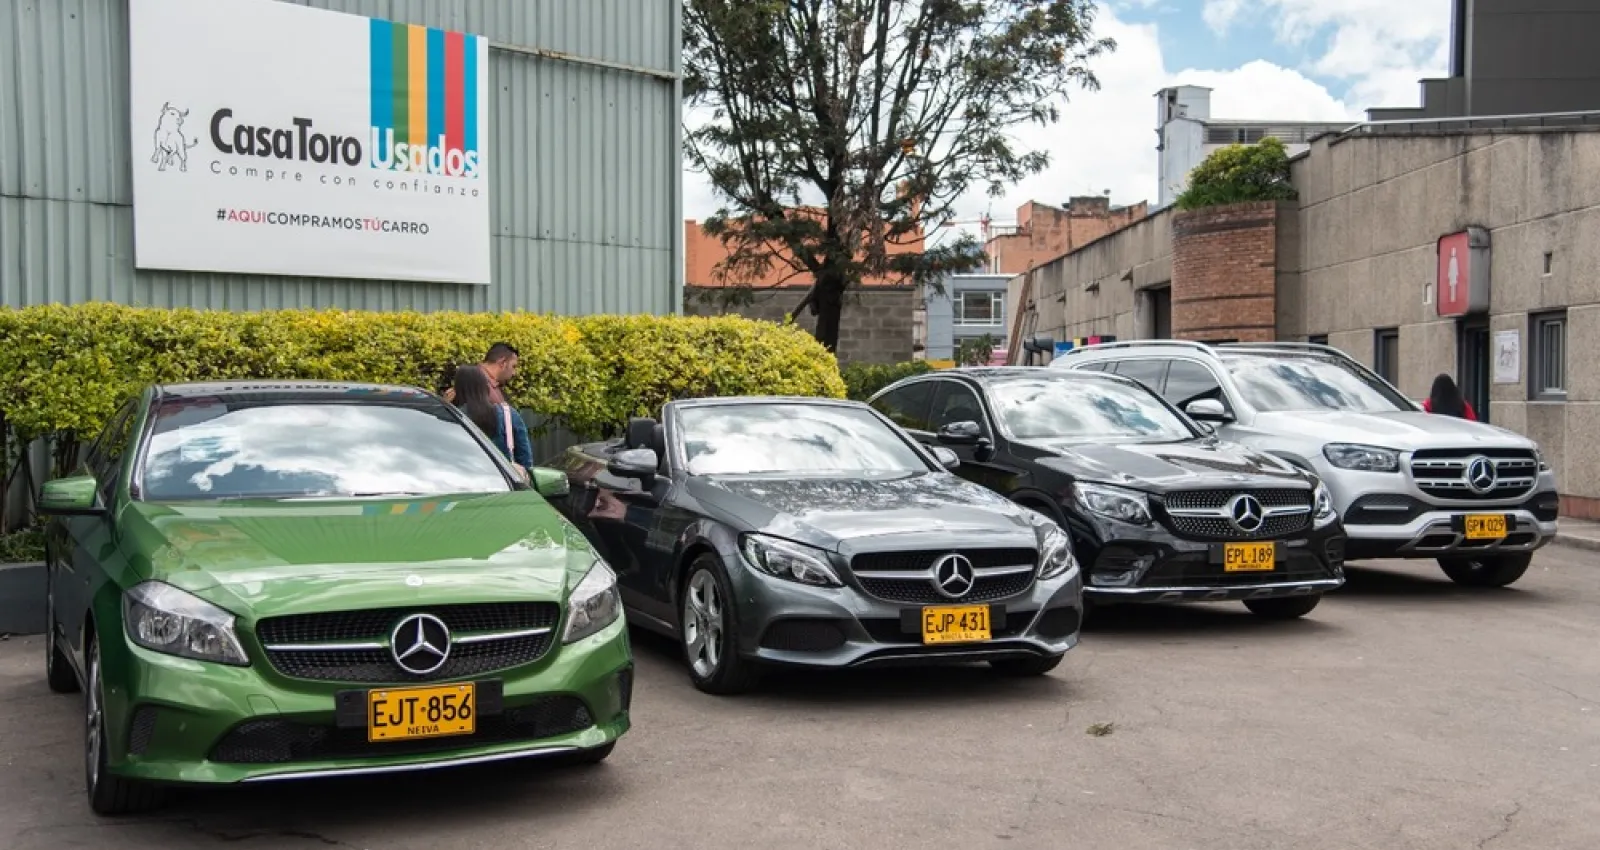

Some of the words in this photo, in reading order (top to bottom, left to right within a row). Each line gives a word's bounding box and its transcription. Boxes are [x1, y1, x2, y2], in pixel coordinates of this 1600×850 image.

[210, 107, 362, 167] CasaToro
[371, 126, 479, 178] Usados
[210, 160, 302, 181] Compre
[320, 175, 356, 187] con
[373, 178, 479, 197] confianza
[216, 208, 429, 234] #AQUICOMPRAMOSTÚCARRO
[407, 725, 440, 735] NEIVA
